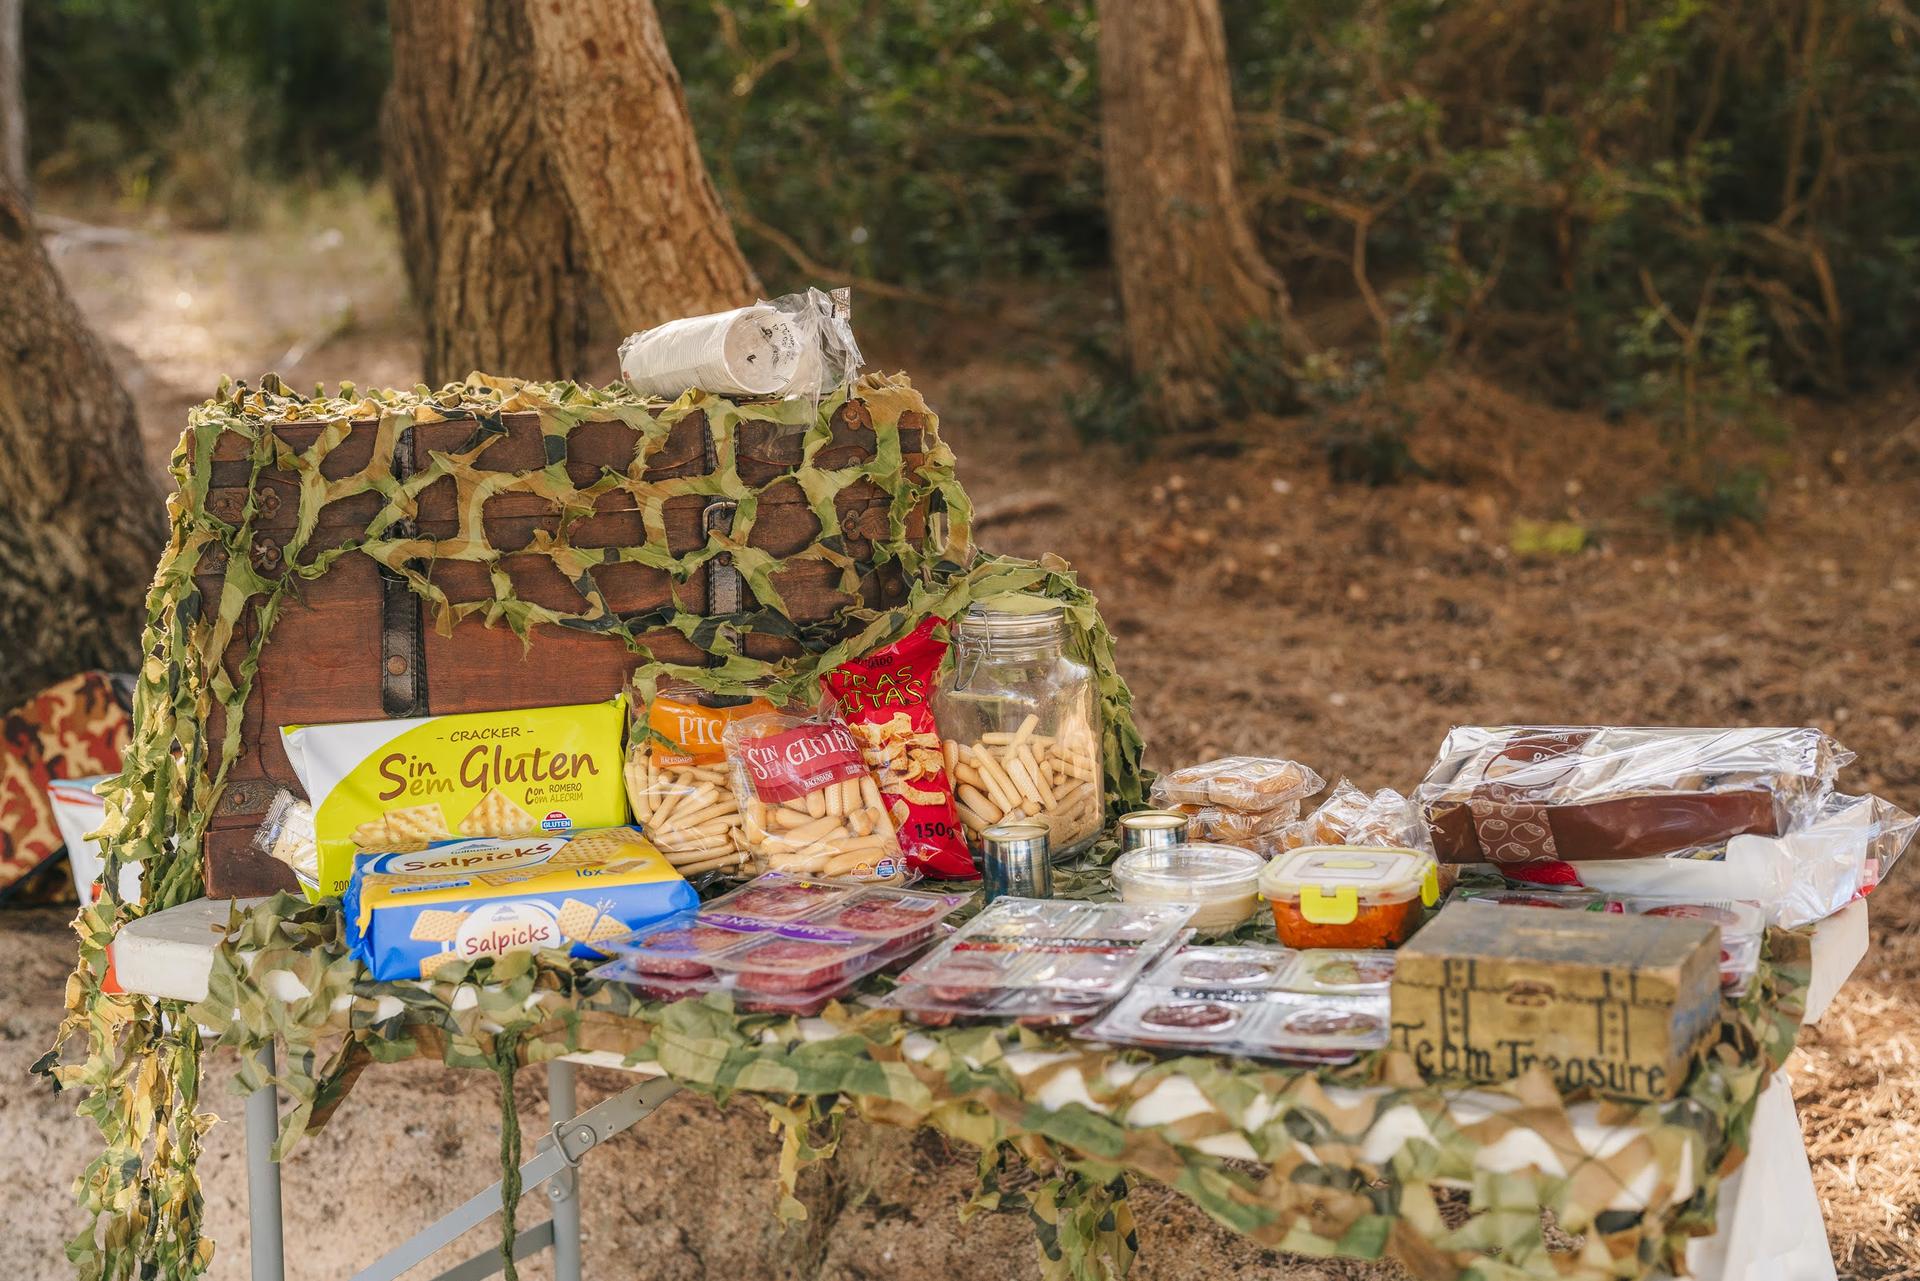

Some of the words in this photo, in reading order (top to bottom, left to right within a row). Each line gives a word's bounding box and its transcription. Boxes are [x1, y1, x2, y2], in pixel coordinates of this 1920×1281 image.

[450, 726, 521, 742] CRACKER
[677, 715, 723, 747] PIC
[747, 745, 779, 780] SIN
[785, 728, 859, 766] GLUTEN
[379, 753, 438, 801] Sin
[459, 744, 600, 794] Gluten
[549, 782, 582, 793] ROMERO
[550, 792, 584, 803] ALECRIM
[543, 821, 571, 829] GLUTEN
[915, 821, 955, 839] 150g
[403, 843, 553, 872] Salpicks
[465, 924, 551, 956] Salpicks
[1391, 1020, 1495, 1082] Team
[1496, 1039, 1668, 1097] Treasure
